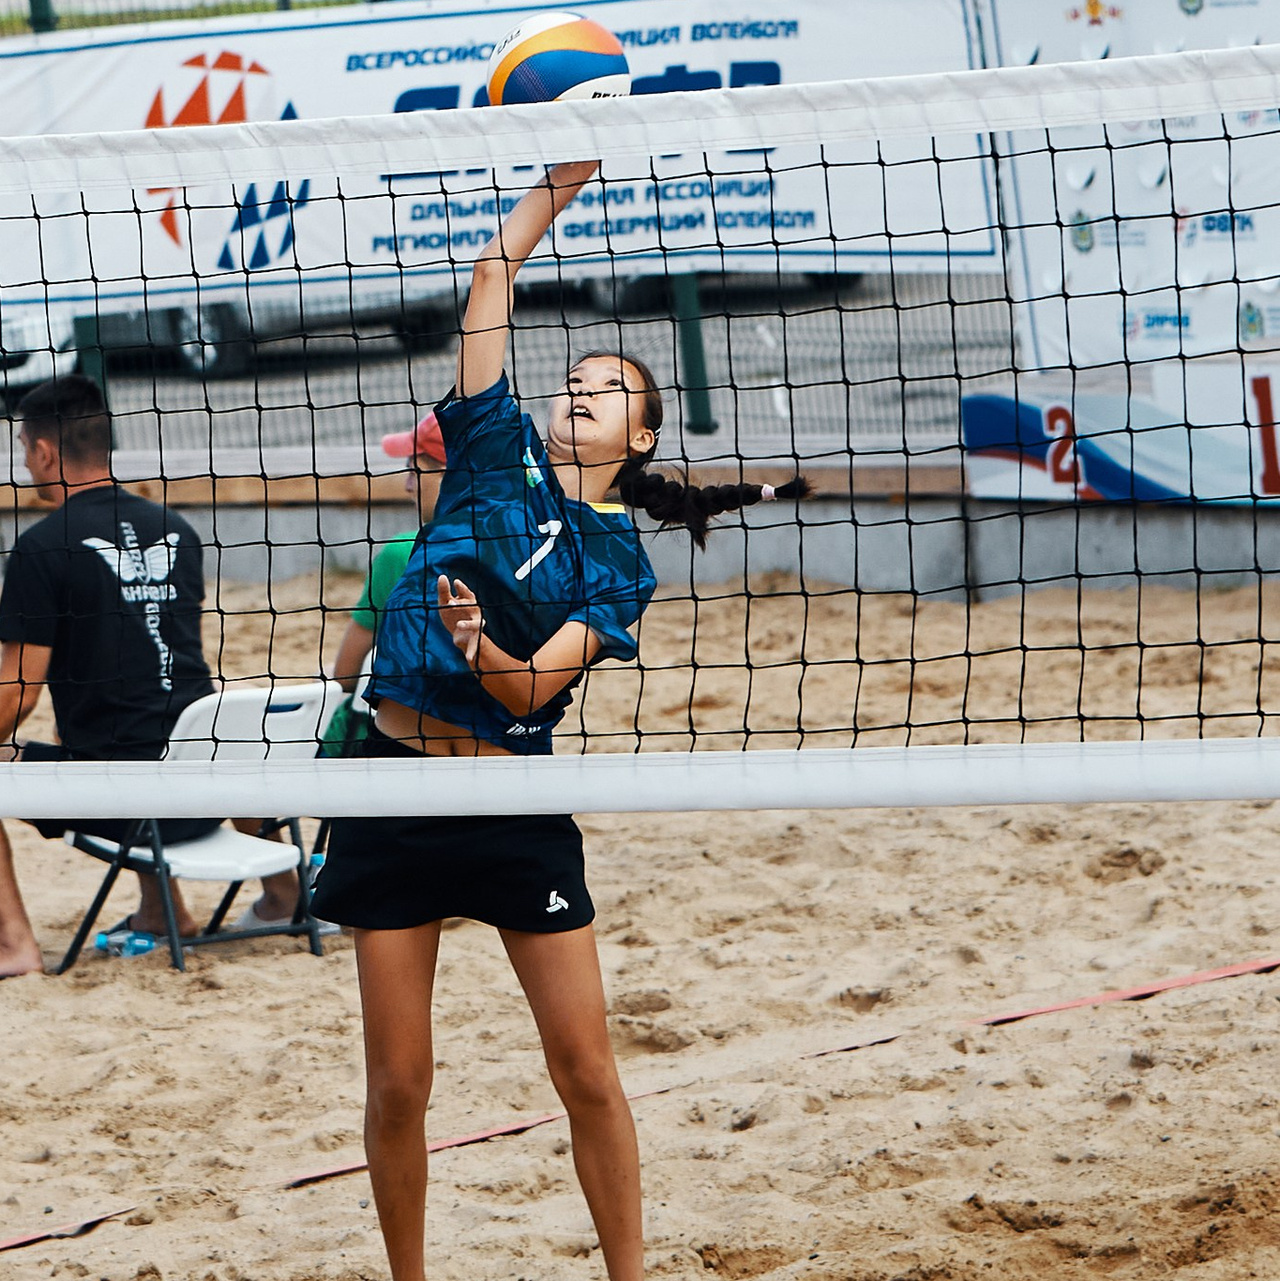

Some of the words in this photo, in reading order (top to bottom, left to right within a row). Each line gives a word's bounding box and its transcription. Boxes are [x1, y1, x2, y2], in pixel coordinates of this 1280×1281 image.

[346, 42, 497, 71] ВСЕРОССИЙС
[691, 18, 798, 42] ВОЛЕЙБОЛА
[645, 179, 776, 204] АССОЦИАЦИЯ
[563, 208, 705, 239] ФЕДЕРАЦИЙ
[1044, 404, 1085, 485] 2
[121, 583, 178, 603] KHABIB
